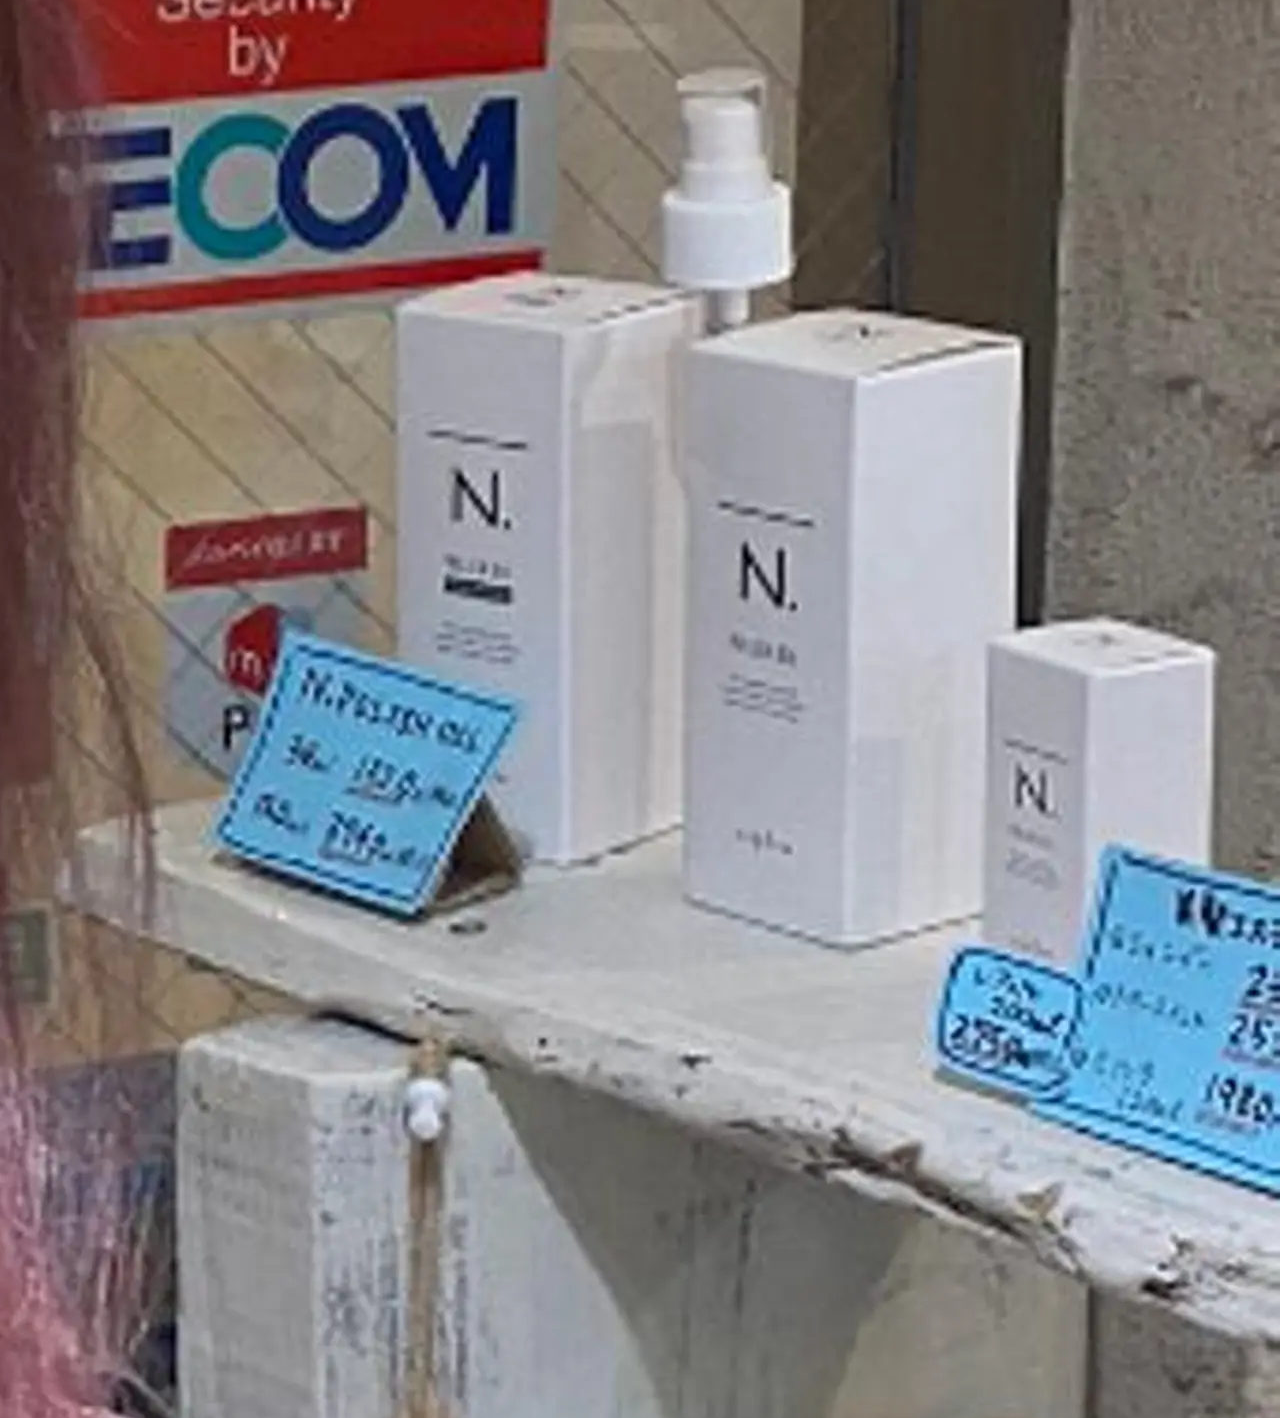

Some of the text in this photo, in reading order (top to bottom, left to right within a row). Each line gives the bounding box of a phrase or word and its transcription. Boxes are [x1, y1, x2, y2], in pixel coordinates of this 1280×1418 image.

[228, 25, 289, 85] by
[85, 96, 519, 273] ECOM
[449, 469, 513, 531] N.
[740, 539, 799, 612] N.
